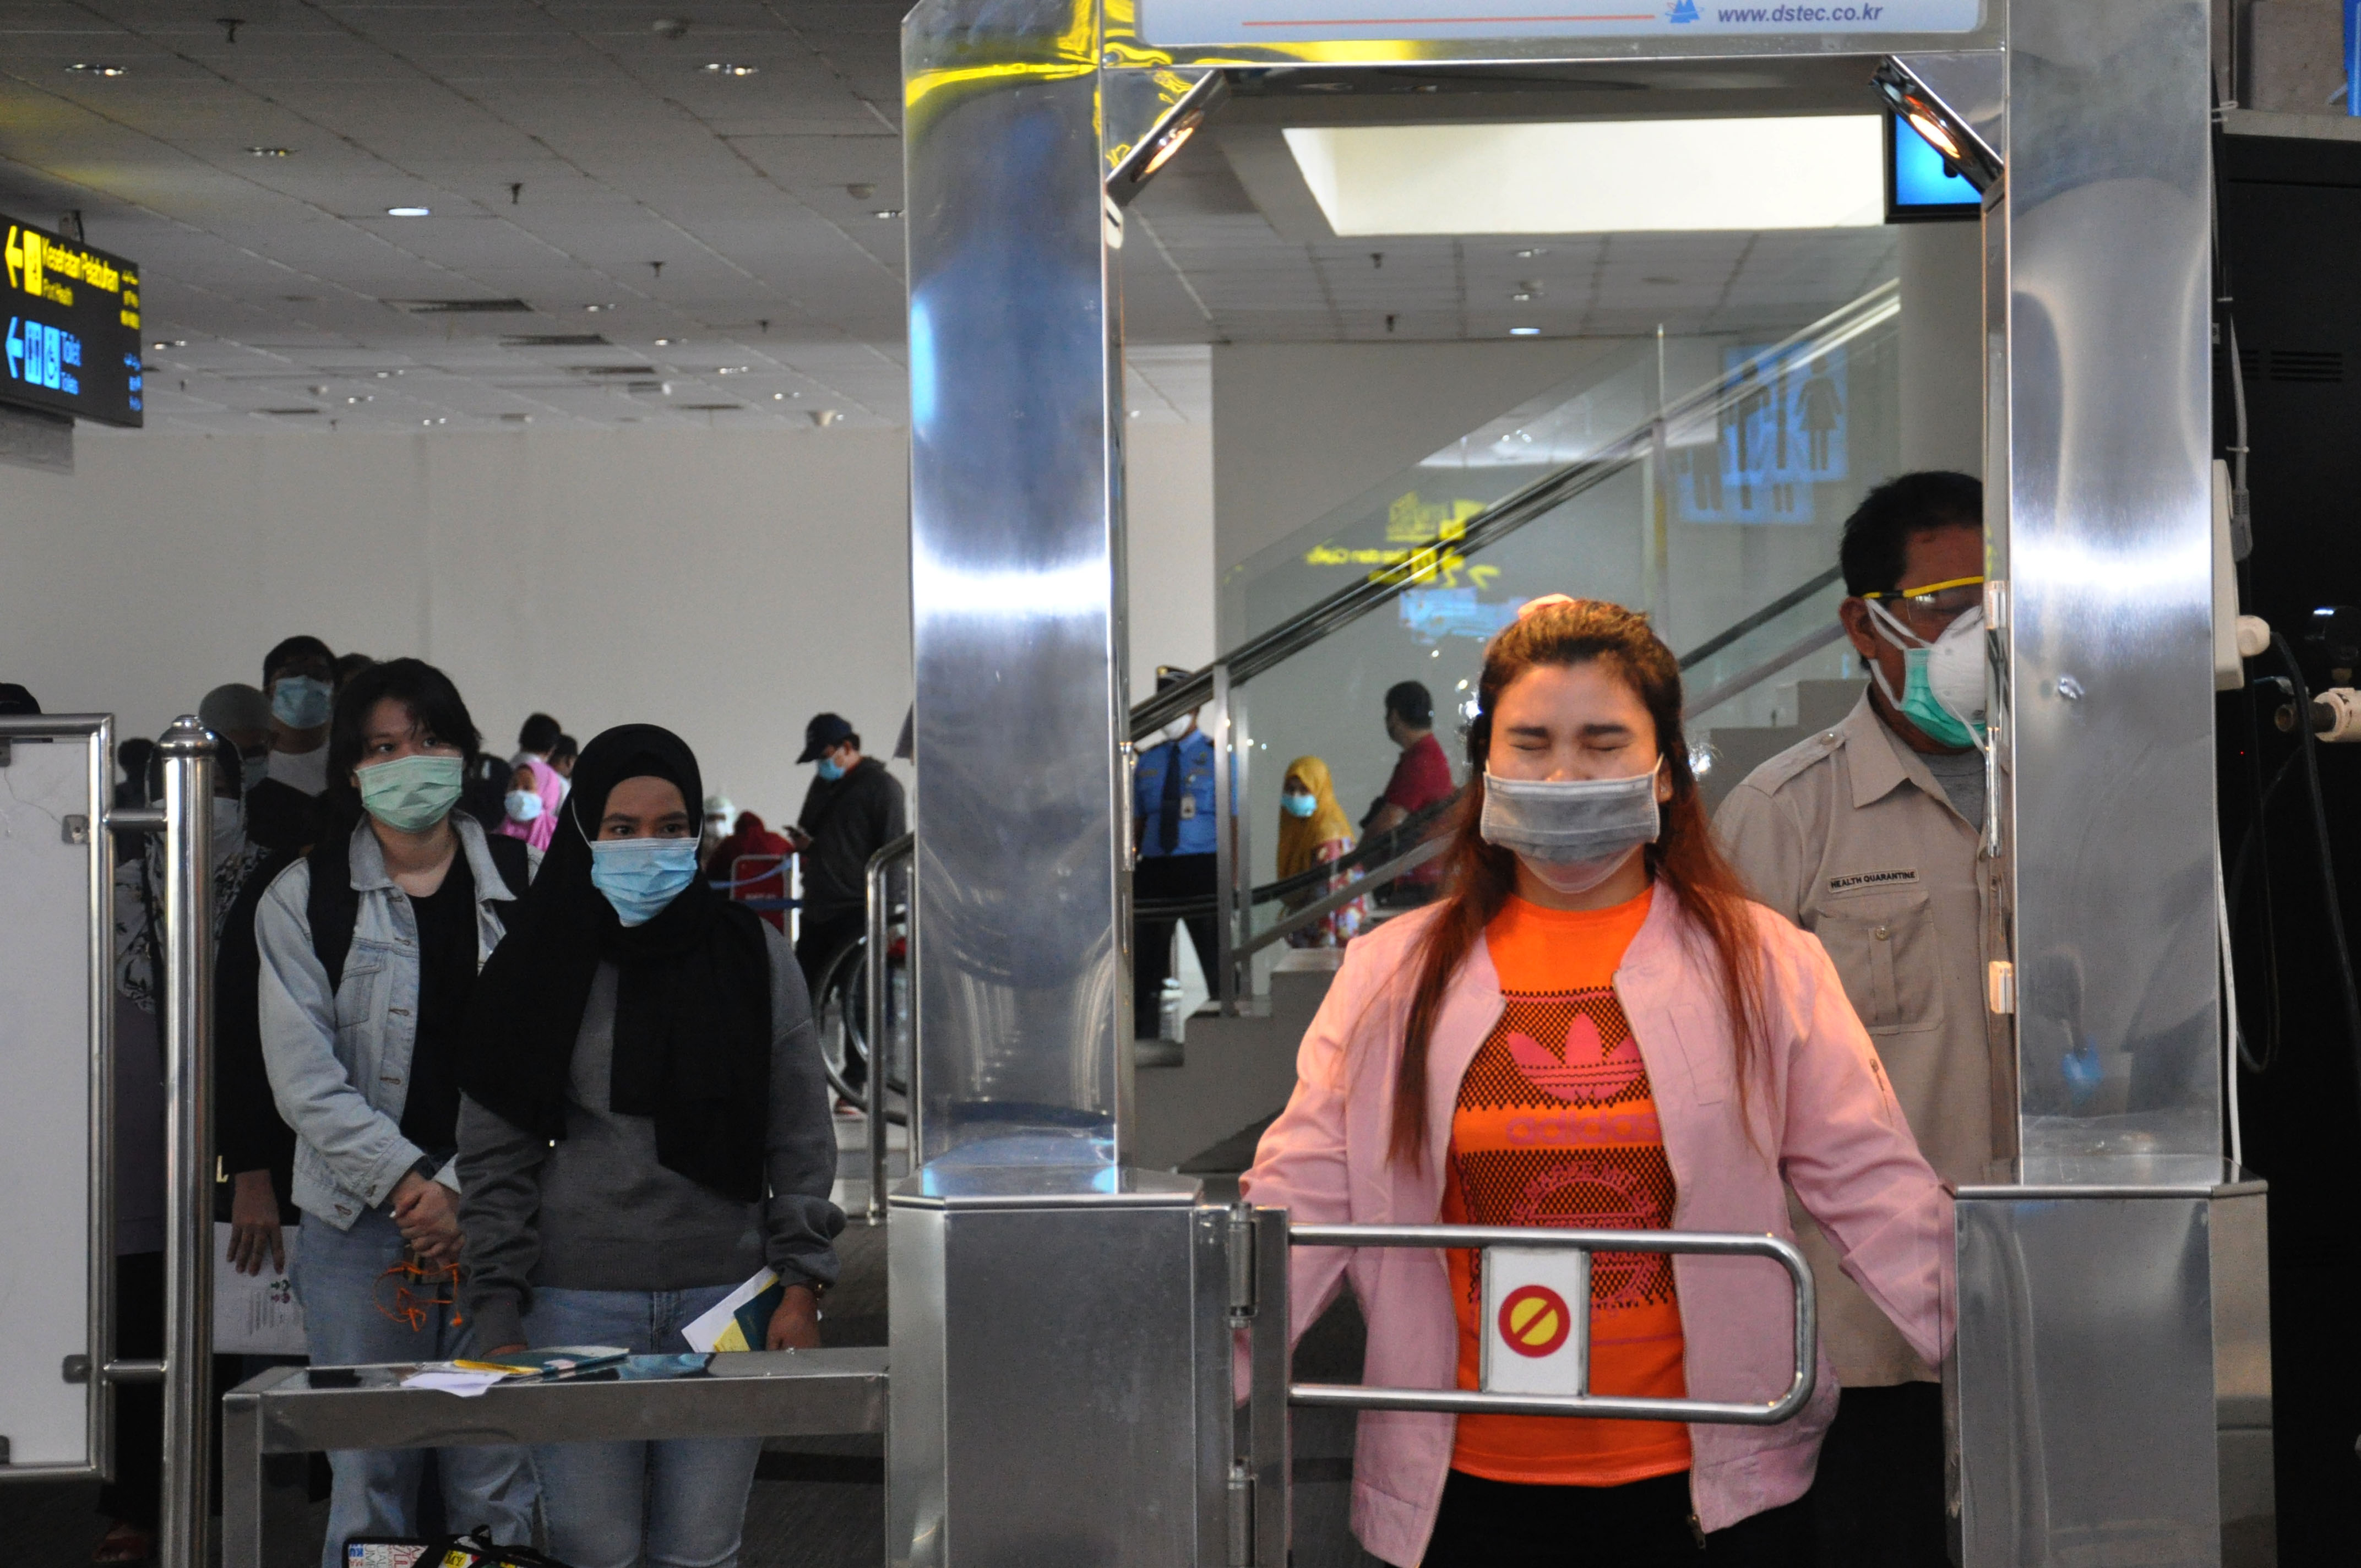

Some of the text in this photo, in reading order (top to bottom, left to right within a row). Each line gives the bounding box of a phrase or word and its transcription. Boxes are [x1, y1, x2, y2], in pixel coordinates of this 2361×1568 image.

[1718, 3, 1883, 22] www.dstec.co.kr
[1830, 871, 1916, 888] HEALTH QUARANTINE
[1506, 1109, 1662, 1146] adidas
